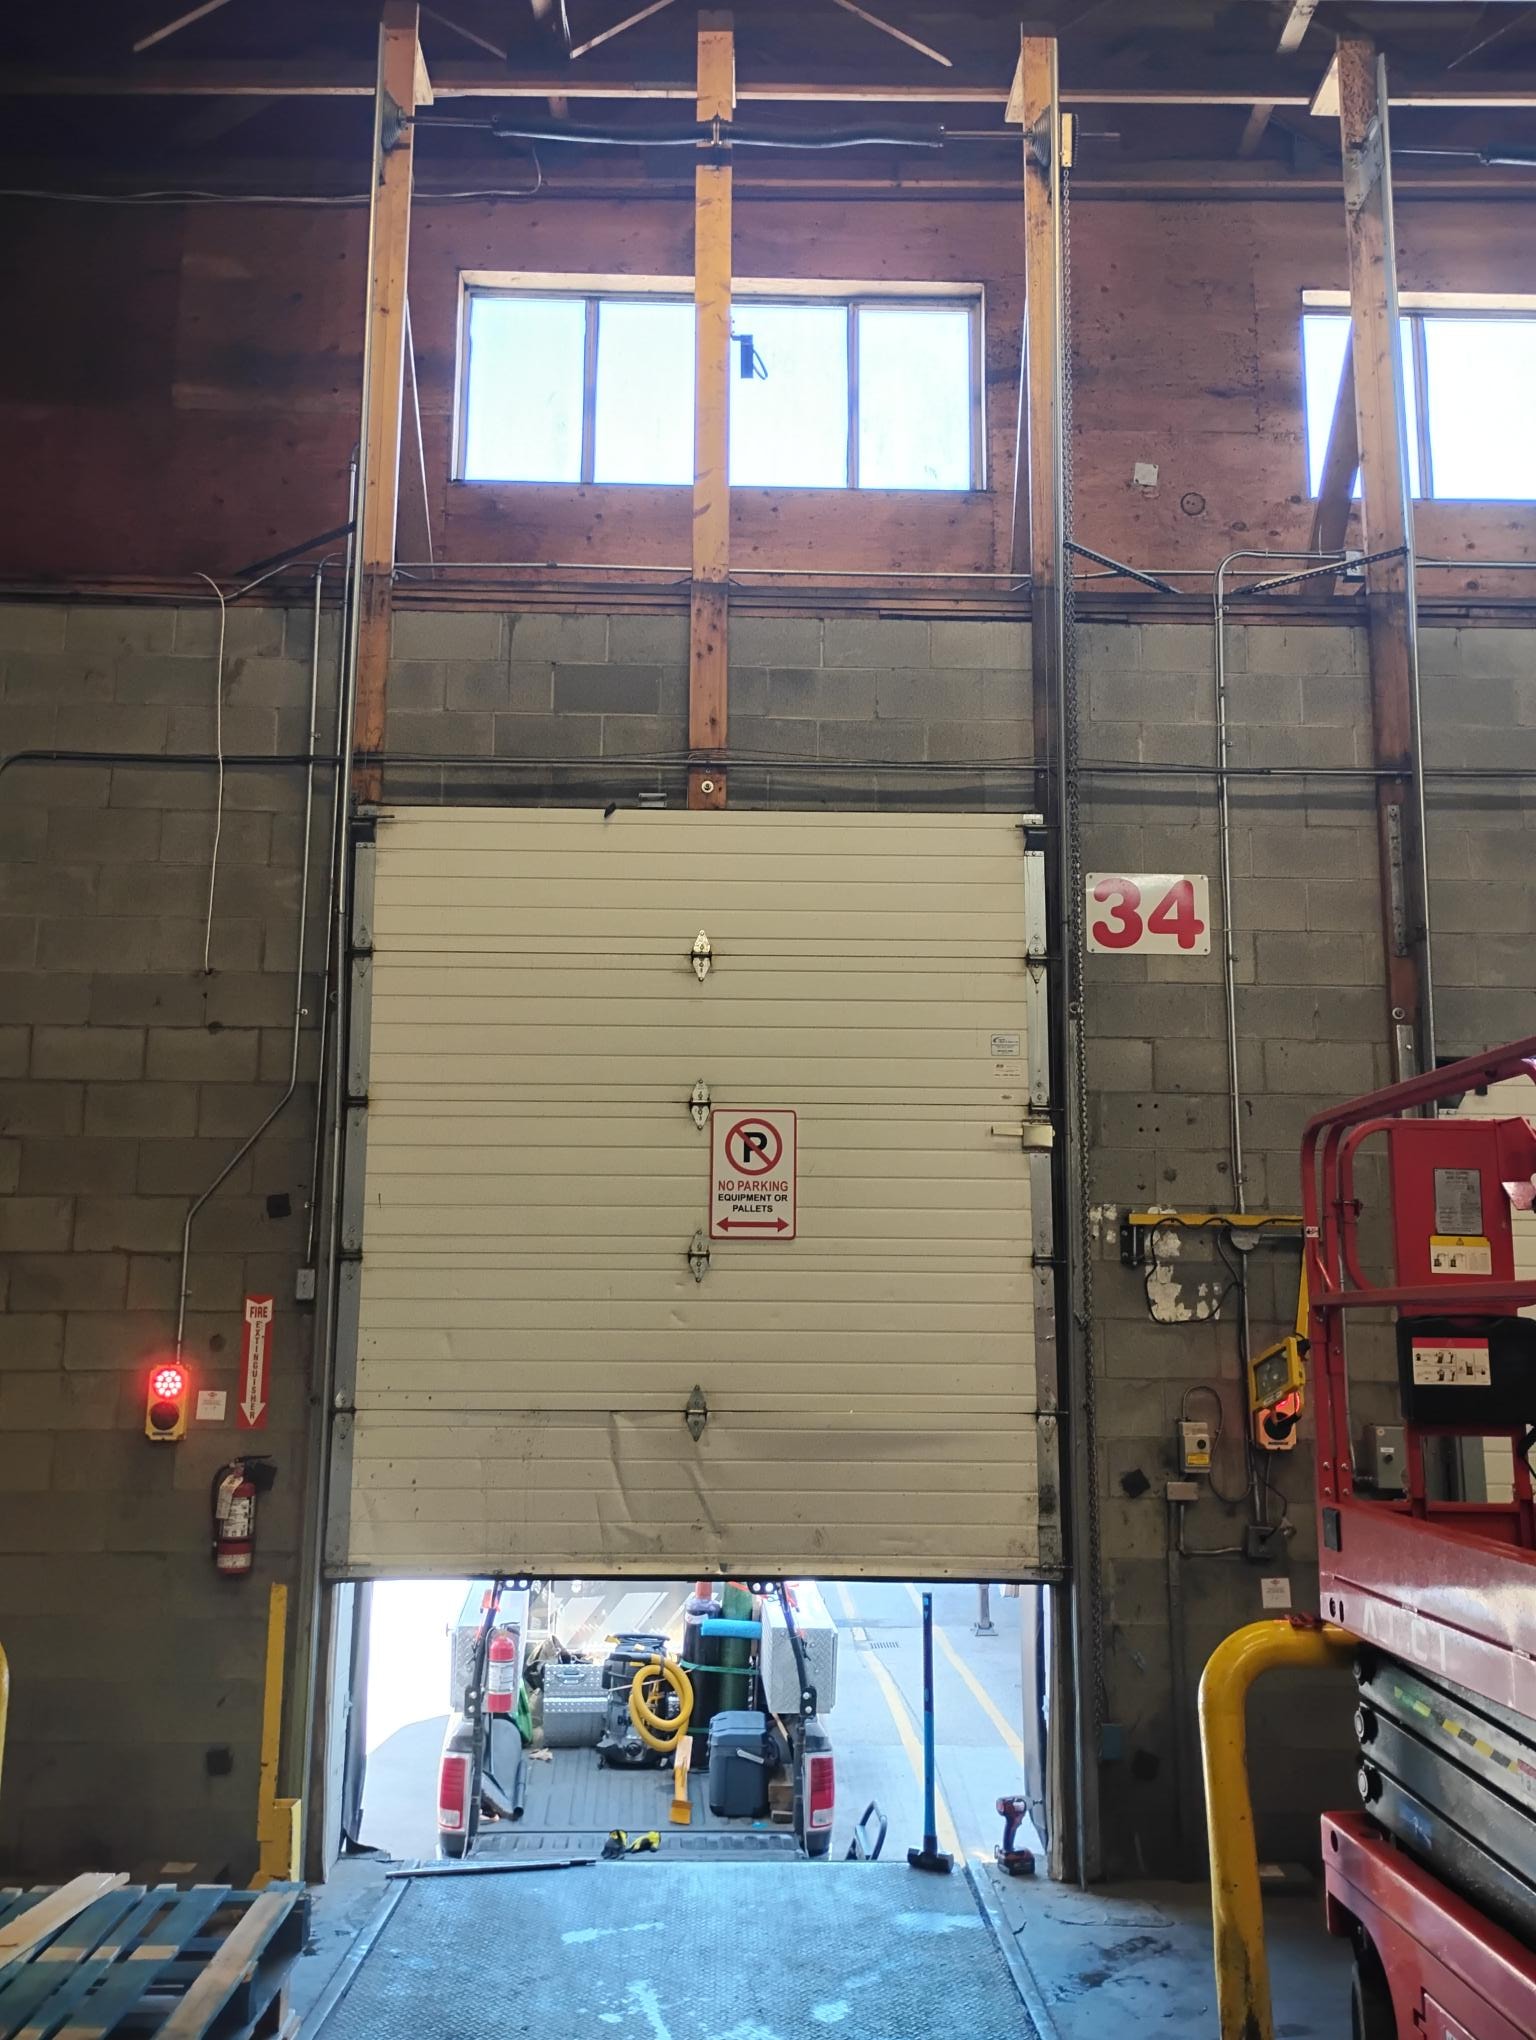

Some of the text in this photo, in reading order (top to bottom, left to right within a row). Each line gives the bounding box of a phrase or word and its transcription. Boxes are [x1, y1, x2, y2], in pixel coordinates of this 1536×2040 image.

[1092, 877, 1205, 950] 34
[718, 1180, 789, 1192] NO PARKING
[718, 1193, 788, 1202] EQUIPMENT OR
[732, 1204, 773, 1213] PALLETS
[249, 1306, 268, 1319] FIRE
[249, 1320, 262, 1419] EXTINGUISHER
